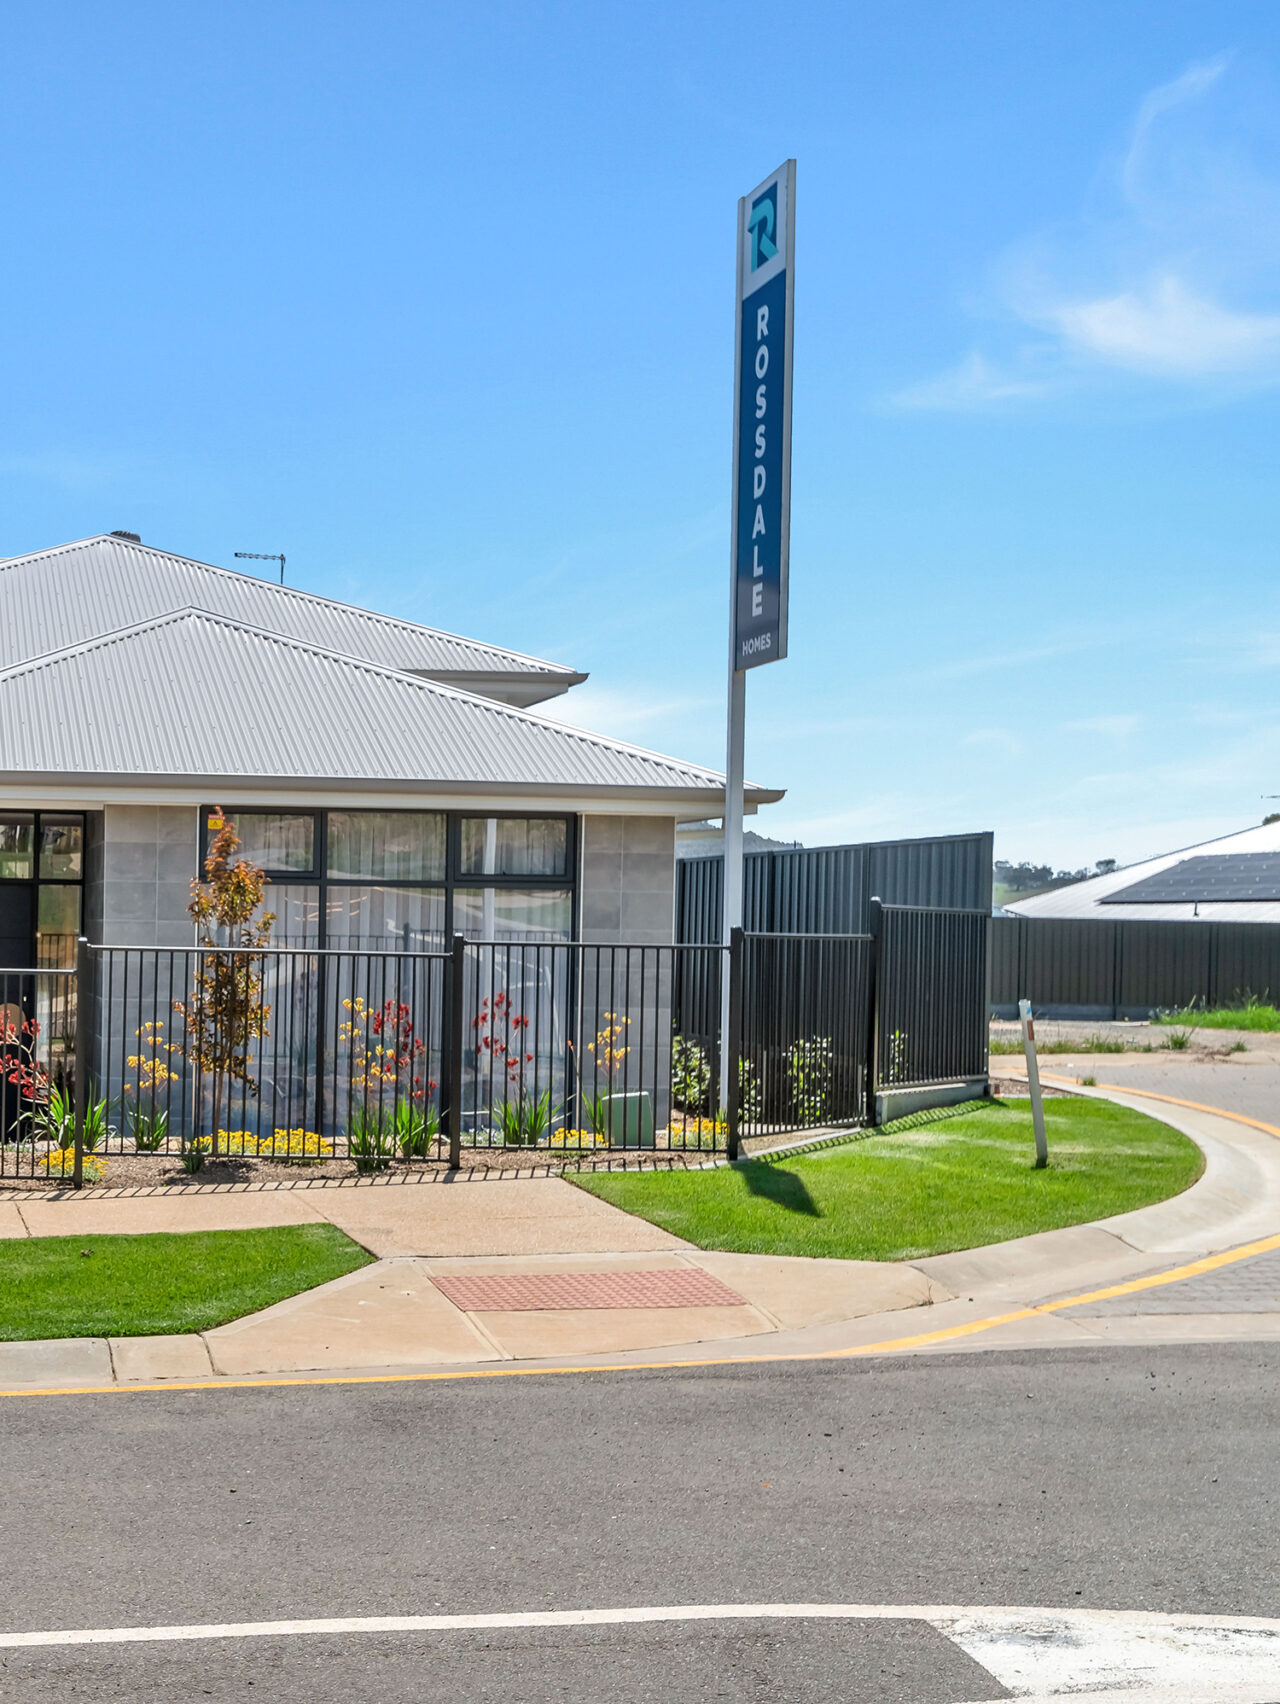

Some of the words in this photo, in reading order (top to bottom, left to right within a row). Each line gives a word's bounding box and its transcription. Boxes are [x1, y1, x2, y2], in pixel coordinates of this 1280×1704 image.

[747, 197, 779, 273] R
[751, 304, 769, 617] ROSSDALE
[742, 632, 771, 657] HOMES
